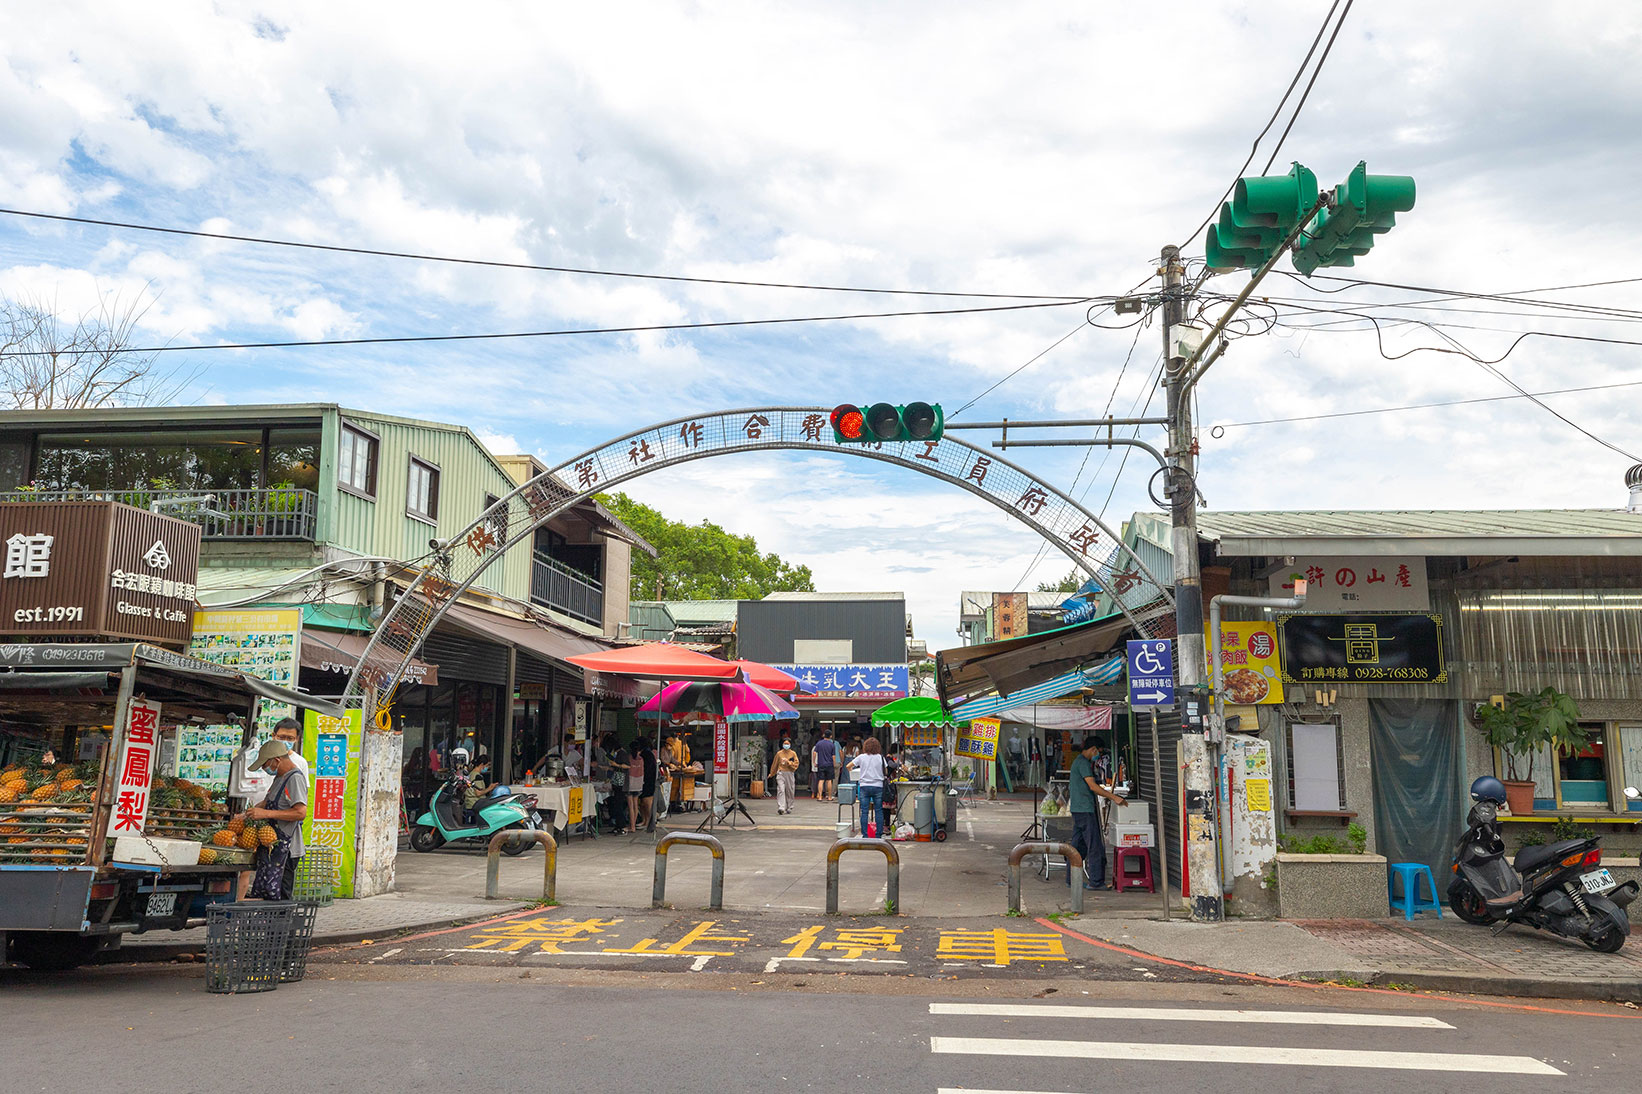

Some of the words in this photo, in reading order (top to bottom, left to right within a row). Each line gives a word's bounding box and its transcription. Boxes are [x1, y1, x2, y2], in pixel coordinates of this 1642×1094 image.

[3, 533, 54, 578] 館
[14, 606, 83, 622] est.1991
[117, 601, 153, 618] Glasses
[154, 607, 162, 620] &
[163, 609, 188, 623] Caffe
[1252, 635, 1271, 657] 湯
[1301, 667, 1350, 679] 訂購專線
[1355, 667, 1429, 679] 0928-768308
[114, 705, 158, 831] 蜜鳳梨
